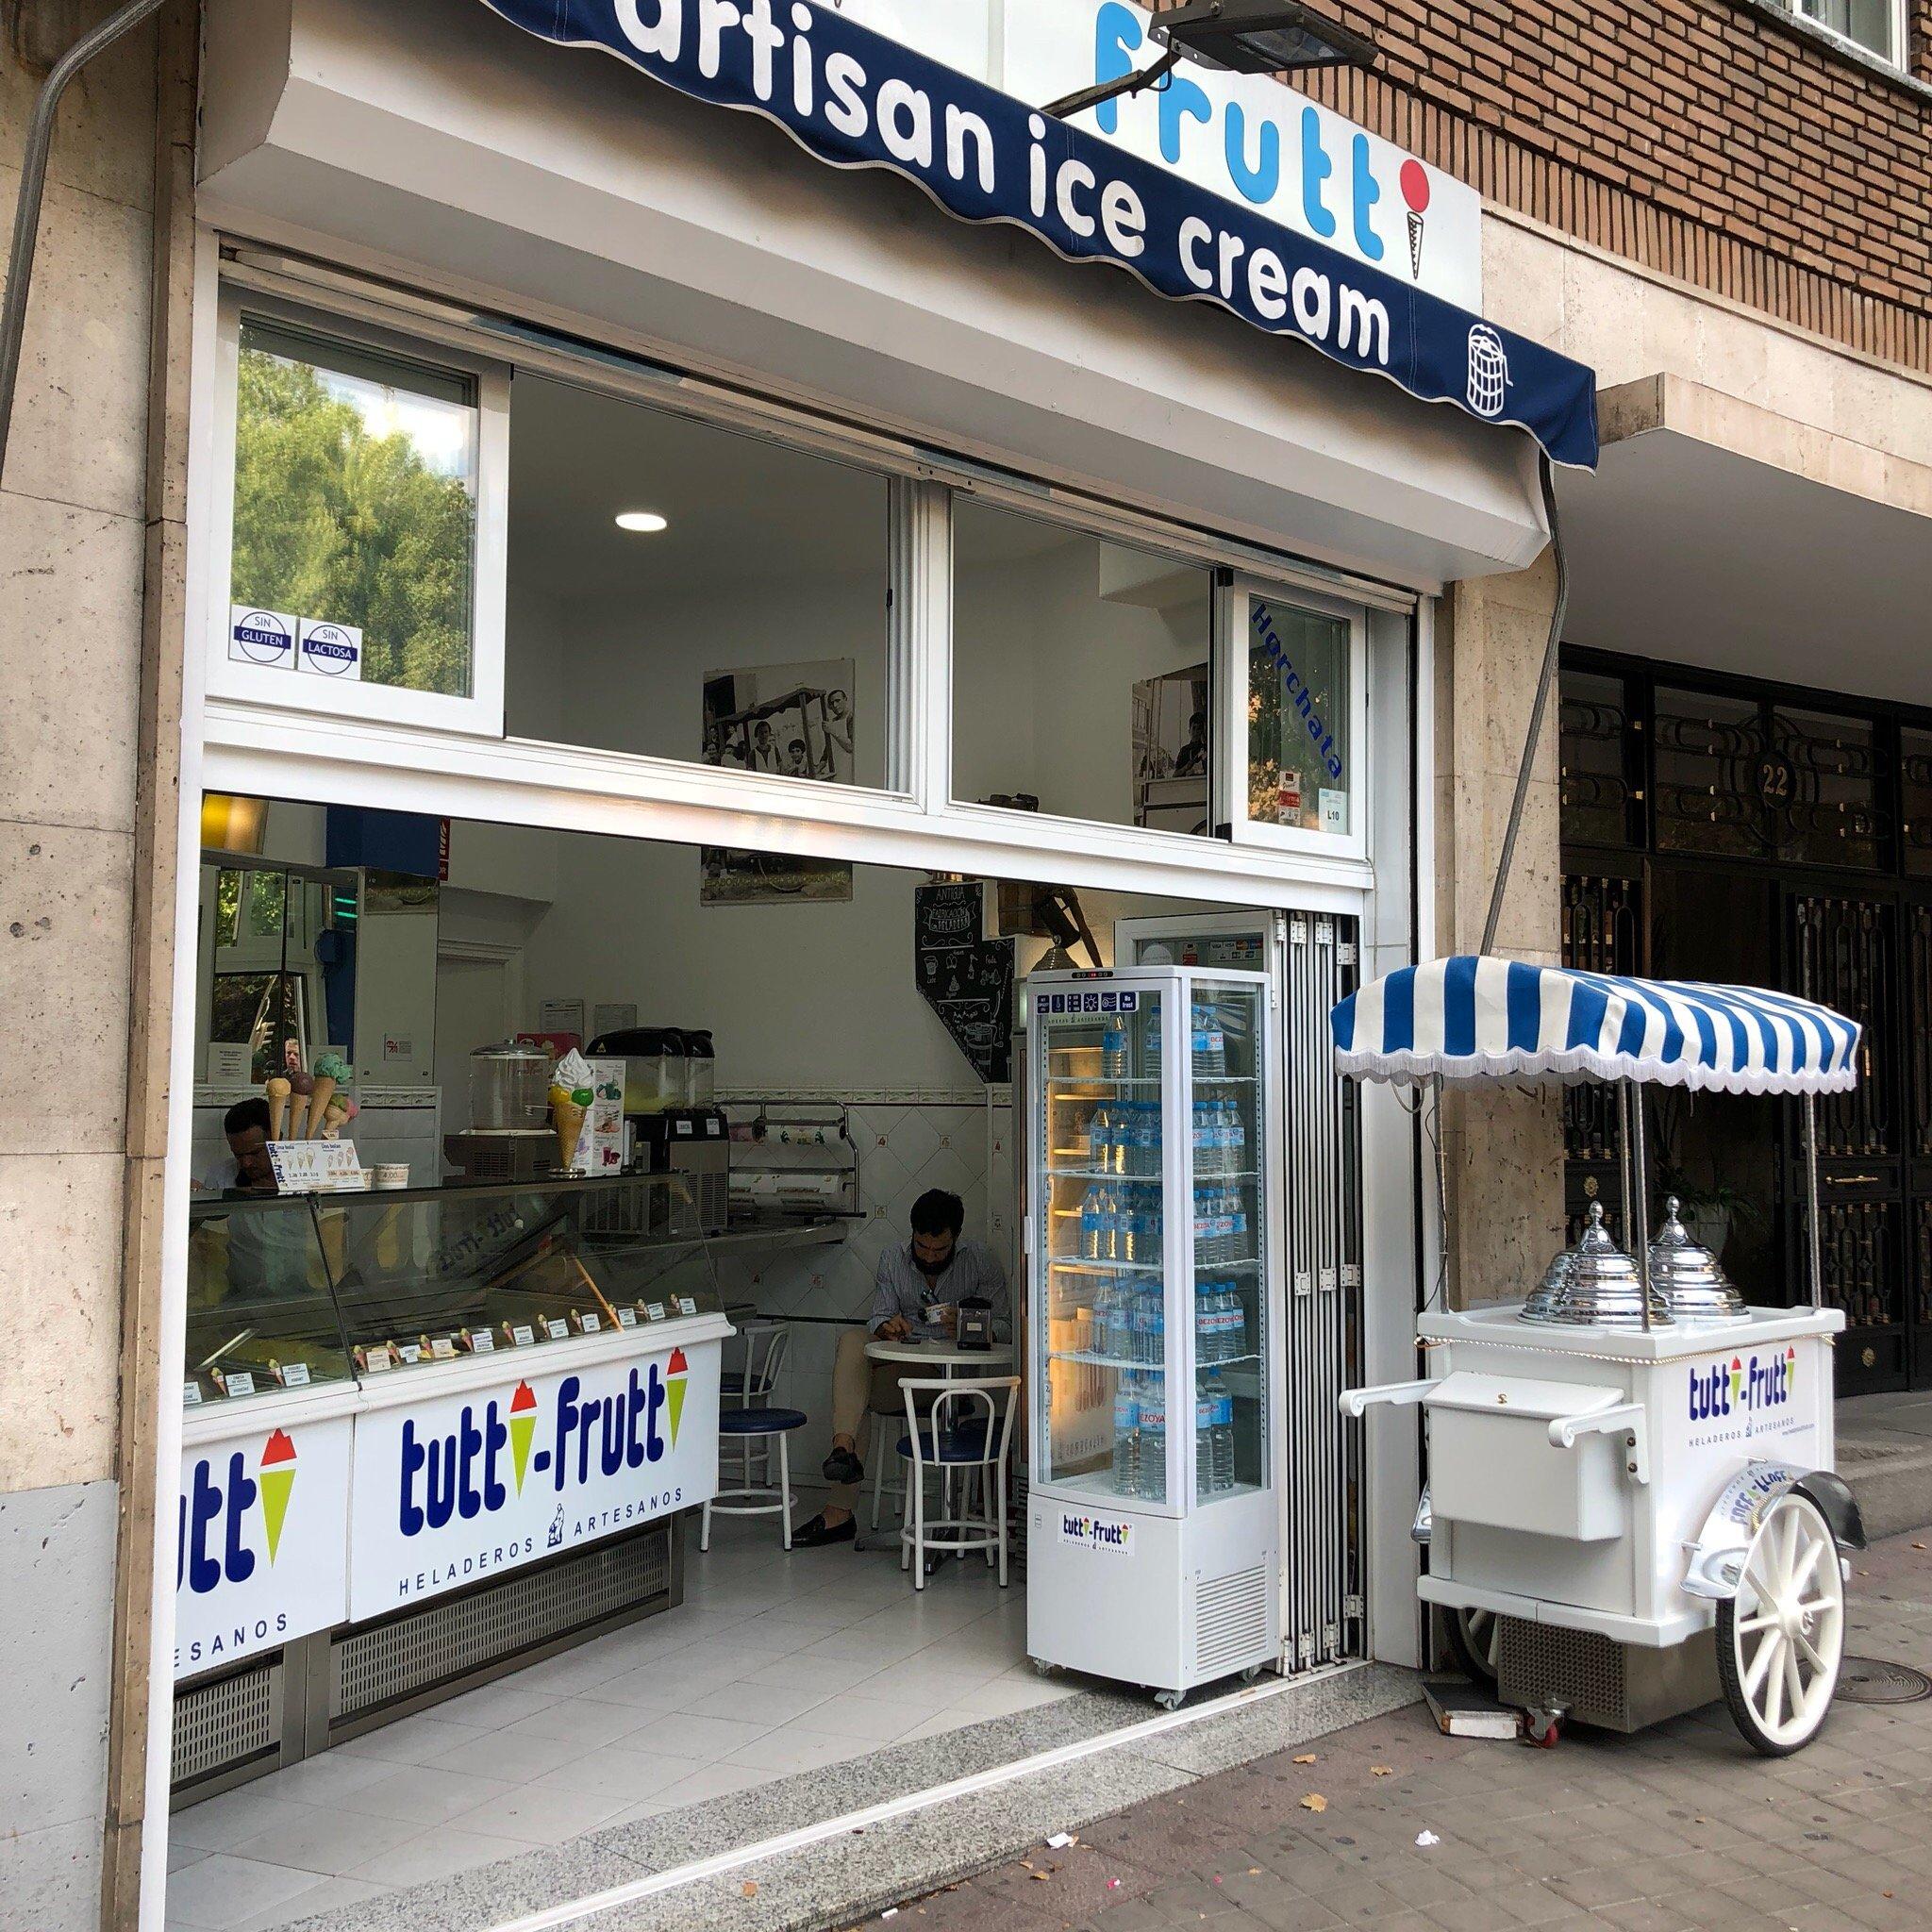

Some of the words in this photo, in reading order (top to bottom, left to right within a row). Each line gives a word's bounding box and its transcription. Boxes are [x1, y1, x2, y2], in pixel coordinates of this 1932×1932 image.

[1095, 1, 1431, 280] frutti
[613, 0, 994, 194] artisan
[1027, 113, 1146, 258] ice
[1177, 215, 1391, 366] cream
[241, 629, 284, 646] GLUTEN
[254, 616, 272, 628] SIN
[322, 628, 339, 641] SIN
[308, 641, 352, 659] LACTOSA
[1251, 603, 1342, 779] Horchata
[1762, 764, 1789, 796] 22
[1327, 809, 1341, 821] L10
[1689, 1344, 1796, 1422] tutti-frutti
[399, 1346, 690, 1538] tutti-frutti
[1688, 1430, 1742, 1447] HELADEROS
[1755, 1416, 1795, 1434] ARTESANOS
[398, 1535, 535, 1596] HELADEROS
[573, 1486, 684, 1538] ARTESANOS
[1063, 1514, 1129, 1545] tutti-frutti
